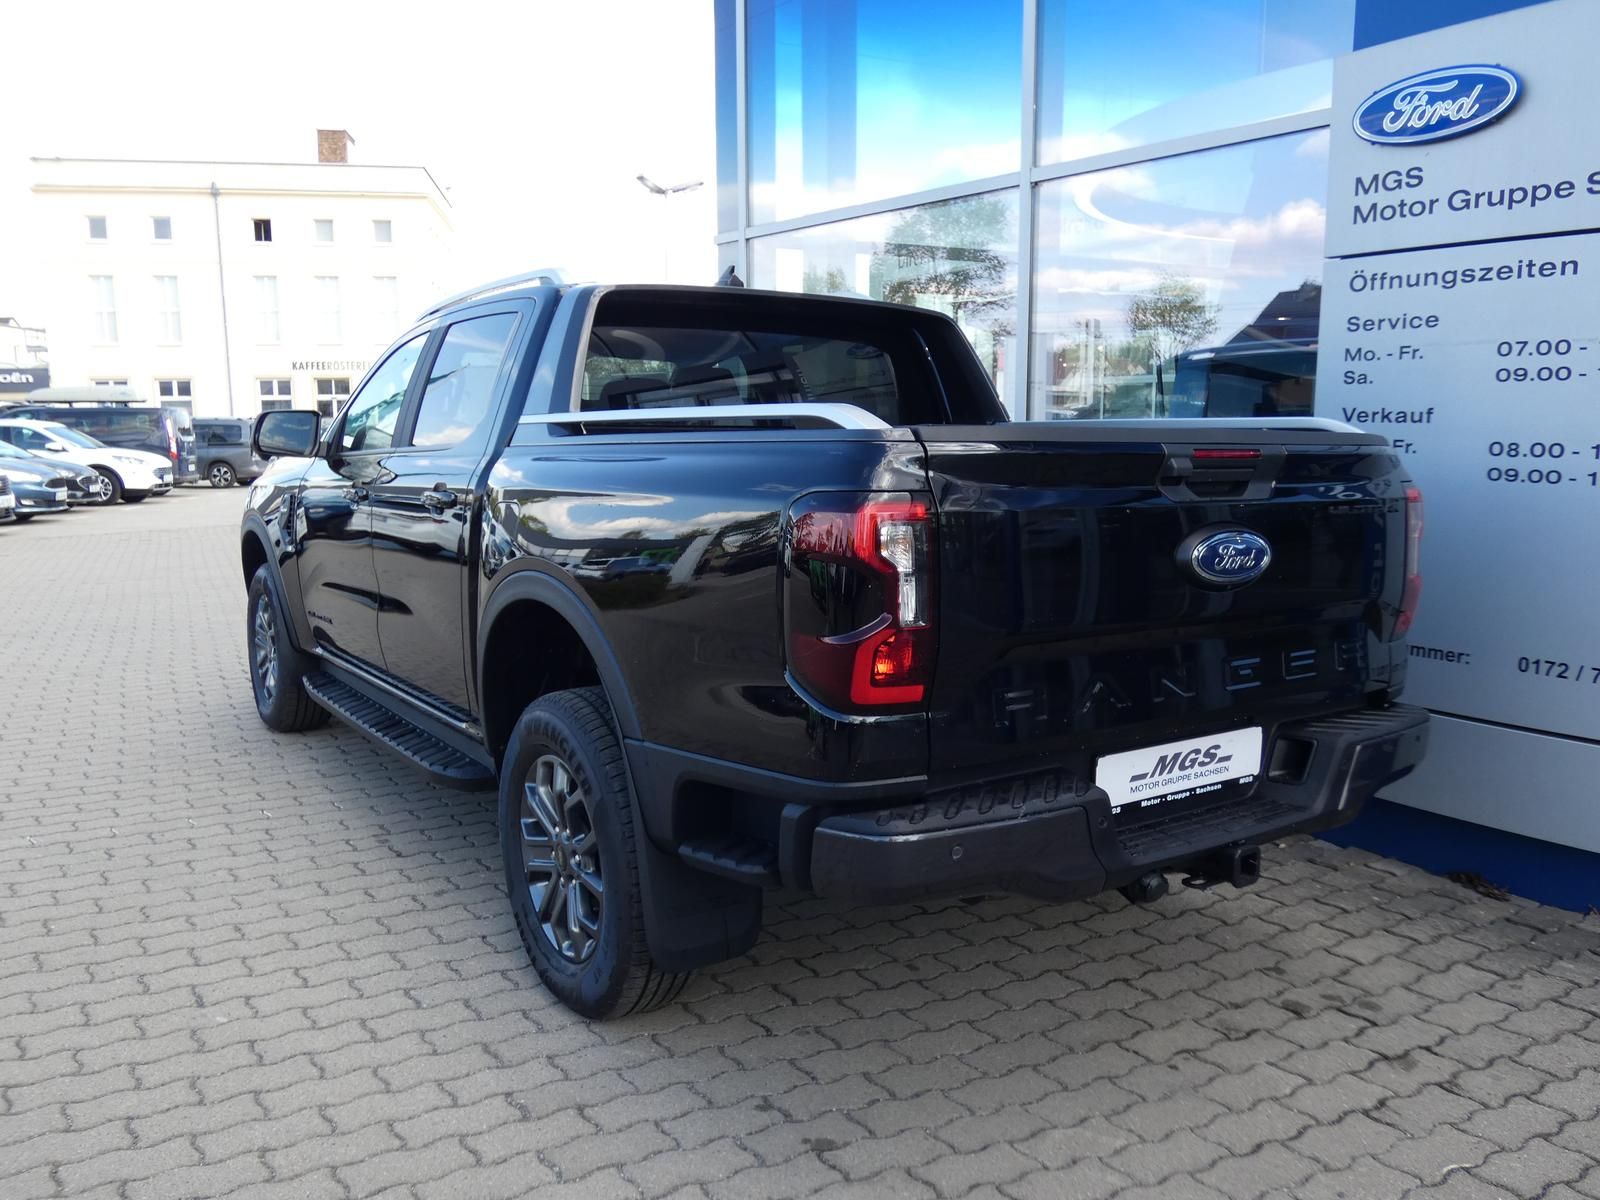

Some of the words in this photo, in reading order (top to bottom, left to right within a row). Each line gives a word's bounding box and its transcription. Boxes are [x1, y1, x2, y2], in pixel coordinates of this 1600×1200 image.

[1383, 80, 1483, 132] Ford
[1354, 166, 1424, 196] MGS
[1353, 196, 1439, 225] Motor
[1447, 179, 1576, 210] Gruppe
[1586, 171, 1600, 195] S
[1349, 259, 1579, 292] Öffnungszeiten
[1346, 313, 1440, 332] Service
[1344, 347, 1381, 362] Mo.
[1398, 345, 1424, 360] Fr.
[1496, 339, 1572, 357] 07.00
[1343, 370, 1374, 385] Sa.
[1495, 366, 1572, 382] 09.00
[1342, 407, 1434, 424] Verkauf
[1393, 439, 1417, 454] Fr.
[1488, 441, 1565, 459] 08.00
[1486, 467, 1562, 484] 09.00
[1214, 543, 1256, 570] Ford
[1407, 644, 1471, 665] mmer:
[1518, 656, 1569, 680] 0172
[1130, 780, 1160, 794] MOTOR
[1161, 773, 1193, 788] GRUPPE
[1193, 765, 1229, 780] SACHSEN
[1141, 798, 1161, 808] Motor
[1166, 791, 1190, 802] Gruppe
[1195, 783, 1222, 795] Sachsen
